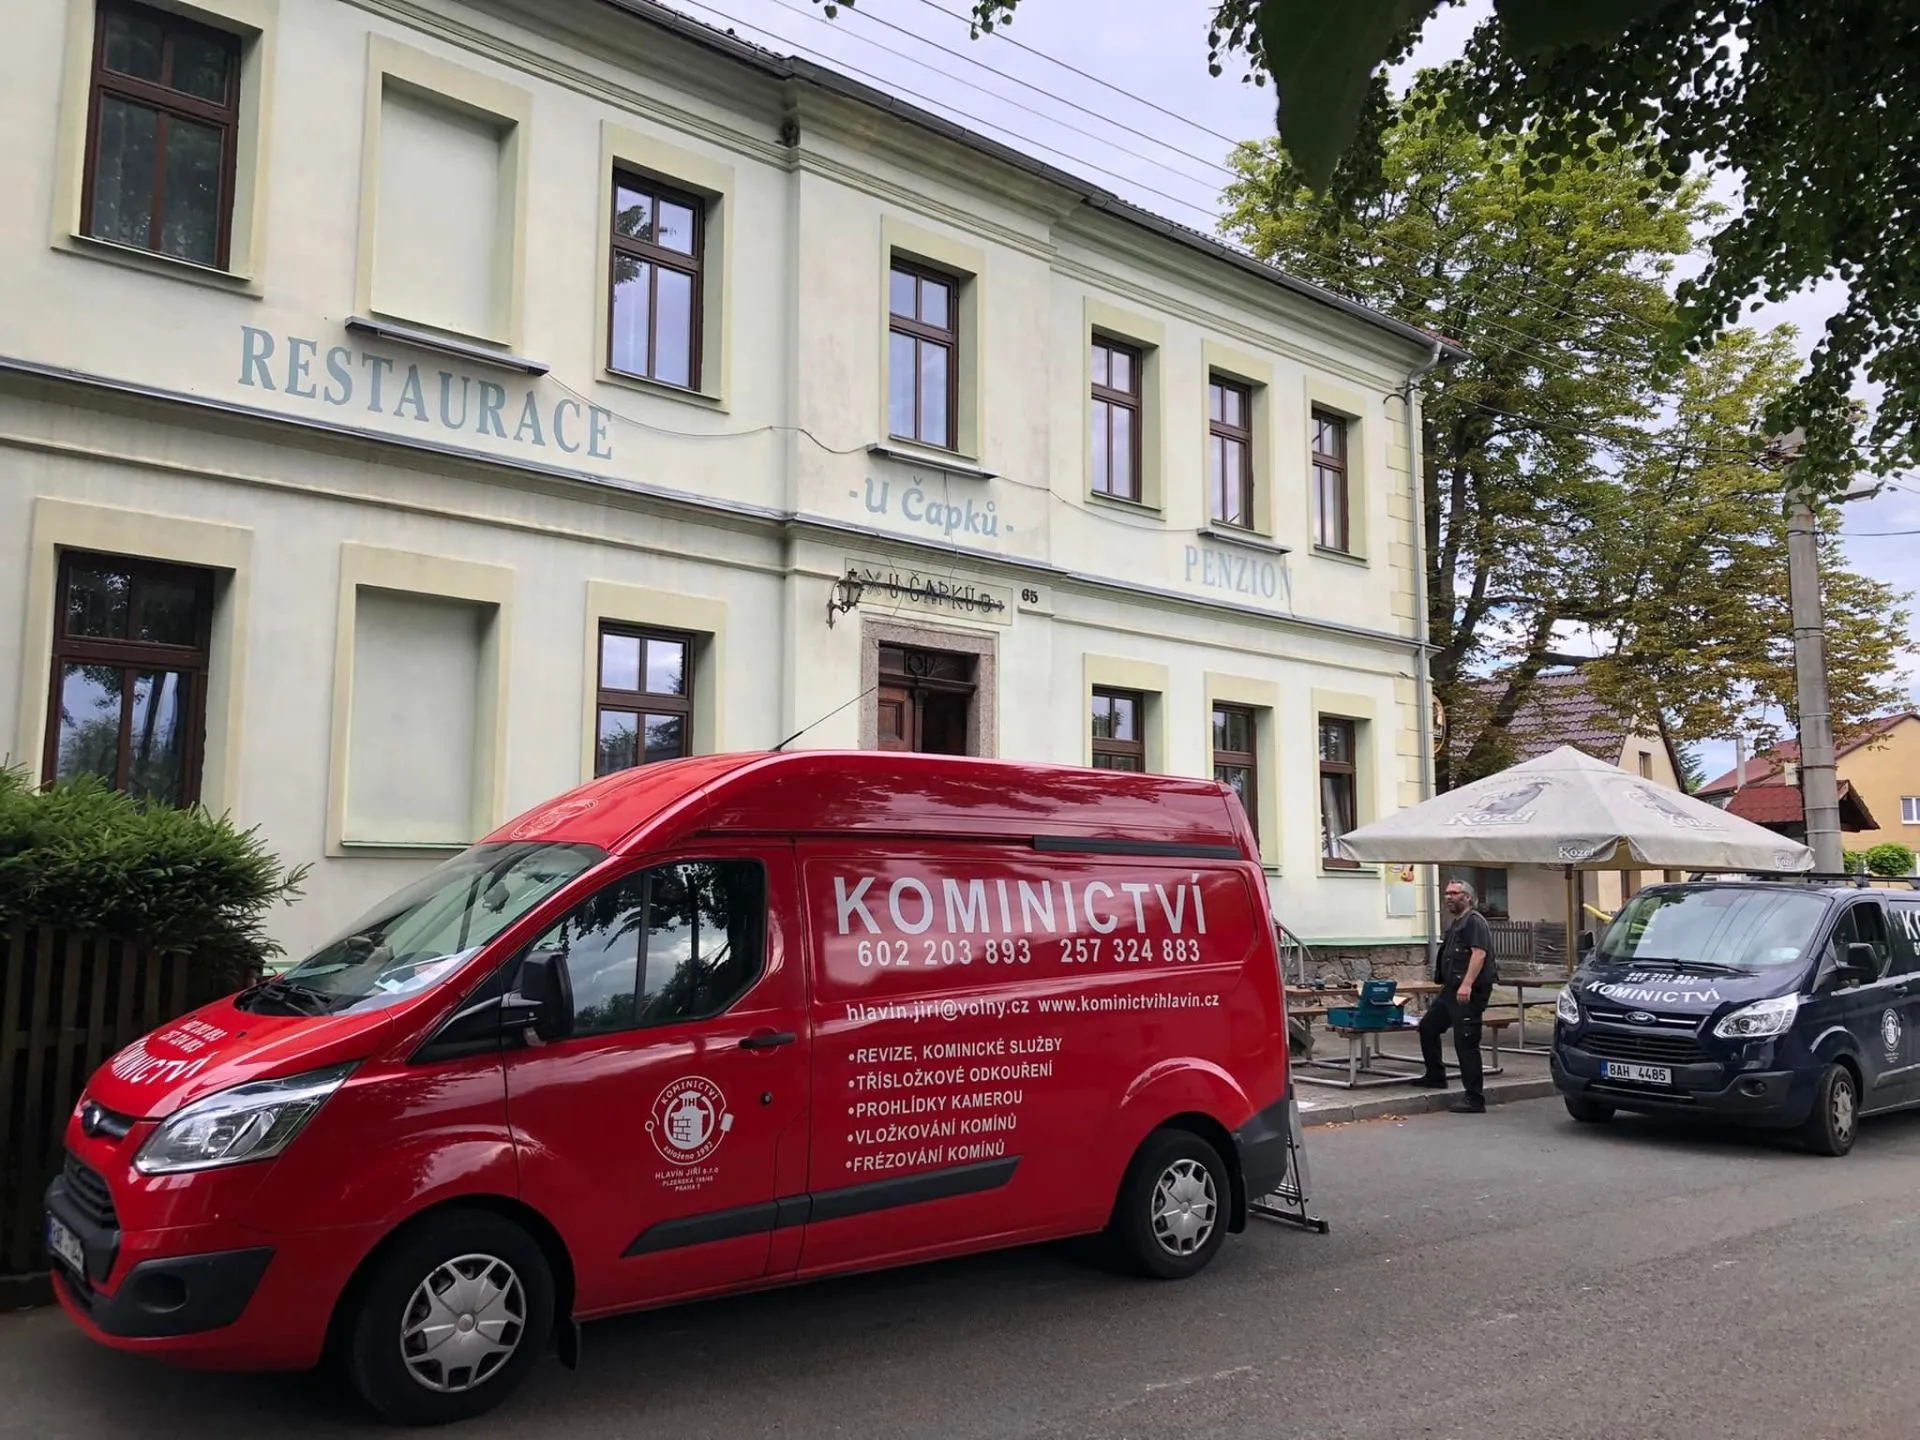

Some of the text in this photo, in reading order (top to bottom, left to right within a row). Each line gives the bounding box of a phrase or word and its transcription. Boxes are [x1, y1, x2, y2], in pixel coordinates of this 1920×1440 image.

[238, 325, 613, 460] RESTAURACE
[901, 476, 998, 537] Čapků
[1185, 545, 1292, 600] PENZION
[1021, 588, 1039, 604] 65
[1558, 846, 1595, 860] Kozel
[832, 873, 1208, 935] KOMINICTVÍ
[857, 938, 1200, 967] 602 203 893 257 324 883
[1585, 980, 1720, 1003] KOMINICTVÍ
[846, 991, 1220, 1023] hlavin.jiri@volny.cz www.kominictvihlavin.cz
[857, 1035, 1063, 1064] REVIZE, KOMINICKÉ SLUŽBY
[857, 1060, 1053, 1091] TŘÍSLOŽKOVÉ ODKOUŘENÍ
[1609, 1064, 1666, 1081] 8AH 4485
[661, 1080, 719, 1105] KOMINICTVÍ
[857, 1090, 1023, 1118] PROHLÍDKY KAMEROU
[856, 1112, 1017, 1145] VLOŽKOVÁNÍ KOMÍNŮ
[854, 1139, 1006, 1172] FRÉZOVÁNÍ KOMÍNŮ
